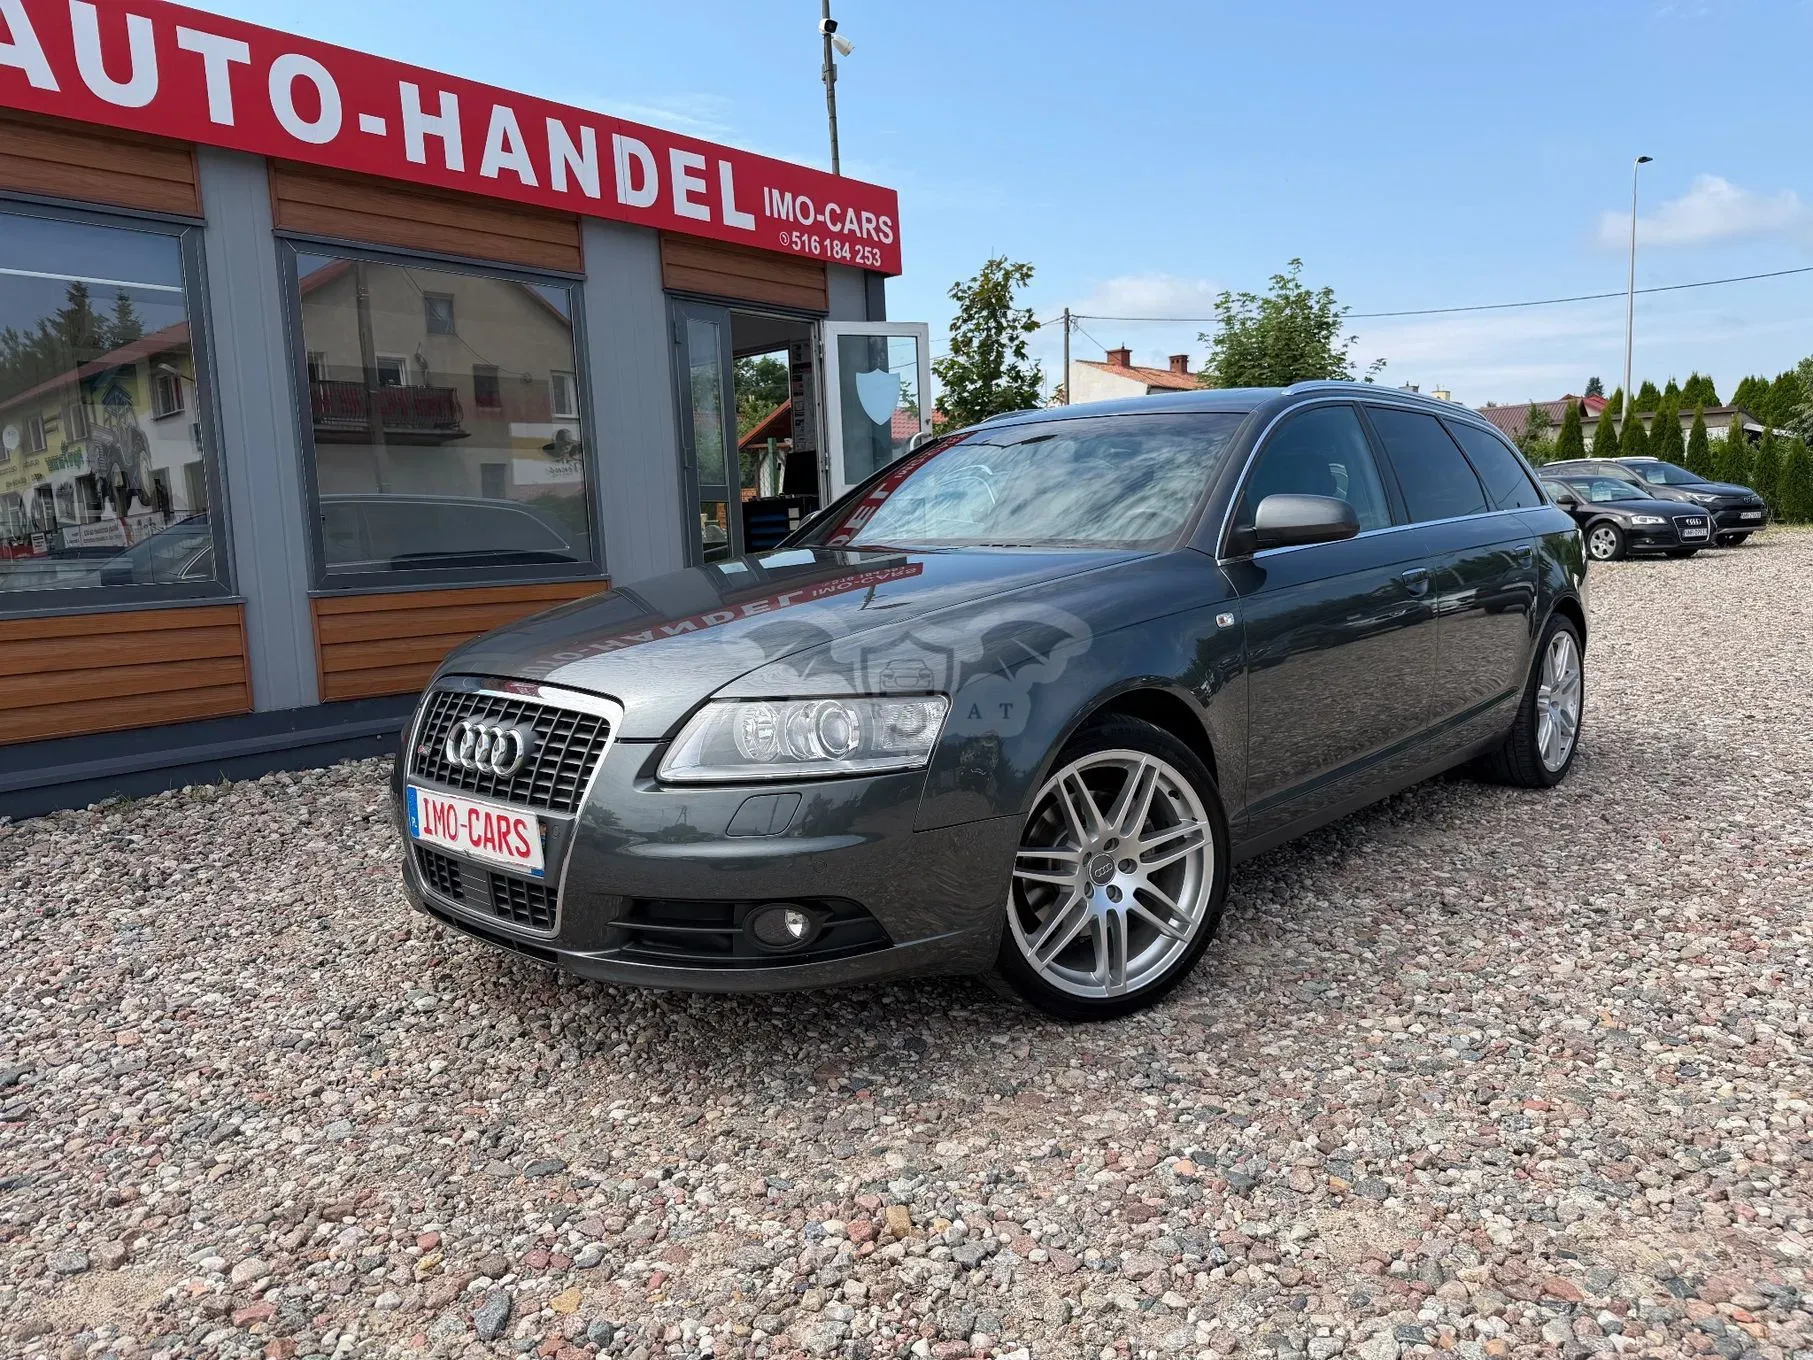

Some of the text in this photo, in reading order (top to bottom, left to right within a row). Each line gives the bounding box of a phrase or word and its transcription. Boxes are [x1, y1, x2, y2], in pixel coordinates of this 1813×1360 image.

[0, 0, 756, 231] AUTO-HANDEL
[763, 186, 894, 245] IMO-CARS
[791, 230, 881, 267] 516 184 253
[422, 796, 531, 859] IMO-CARS
